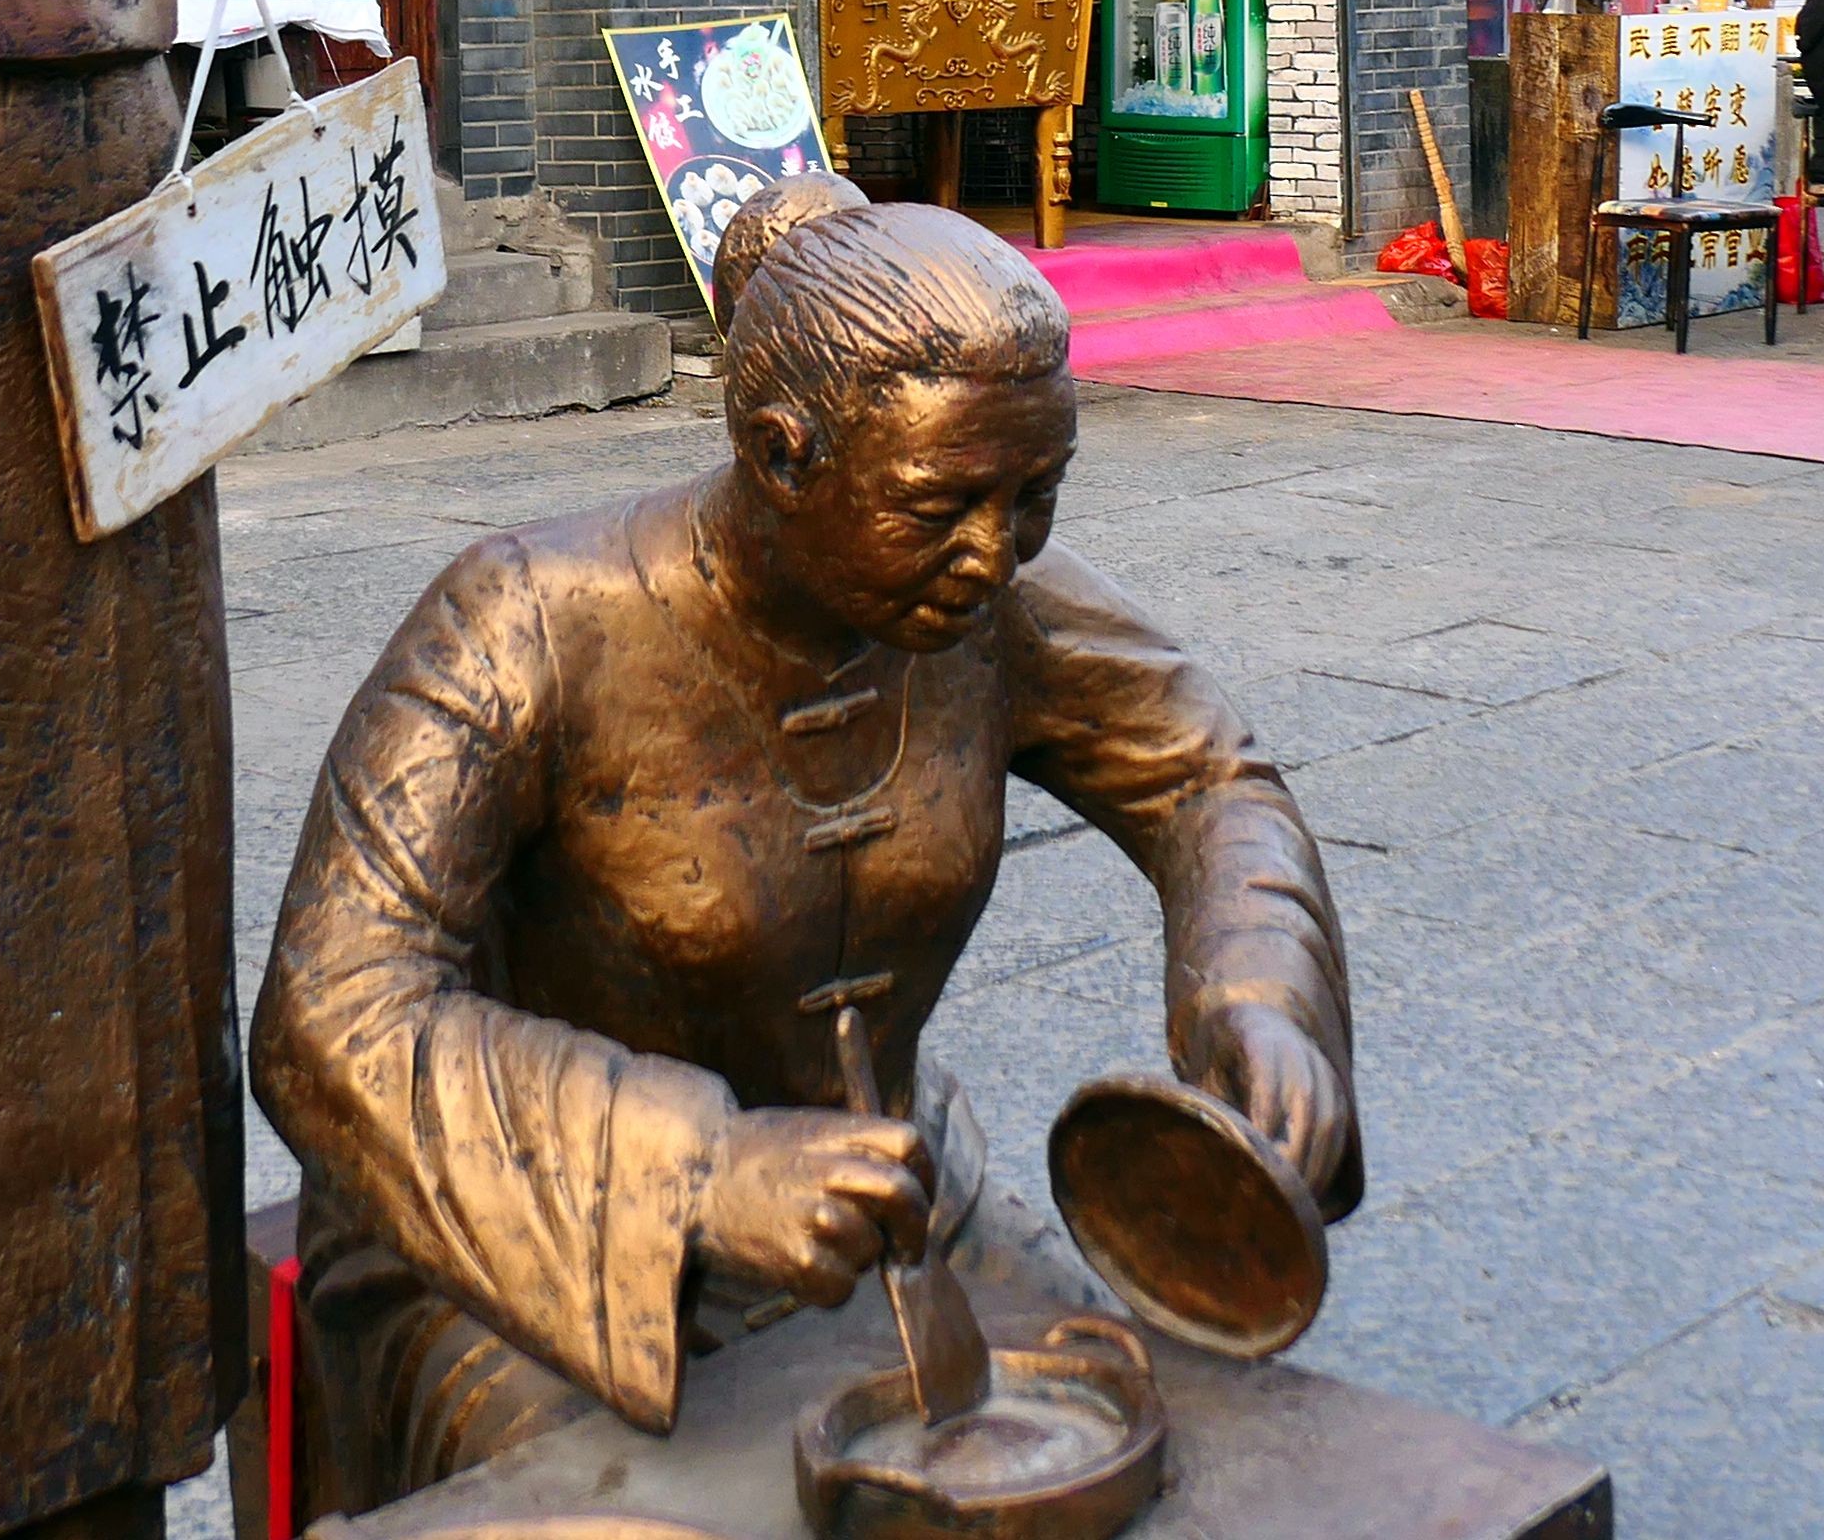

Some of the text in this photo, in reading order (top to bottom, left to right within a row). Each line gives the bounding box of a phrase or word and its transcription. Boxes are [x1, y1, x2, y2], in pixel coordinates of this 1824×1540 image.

[1629, 22, 1770, 60] 武皇不翻汤
[91, 114, 420, 451] 禁止触摸
